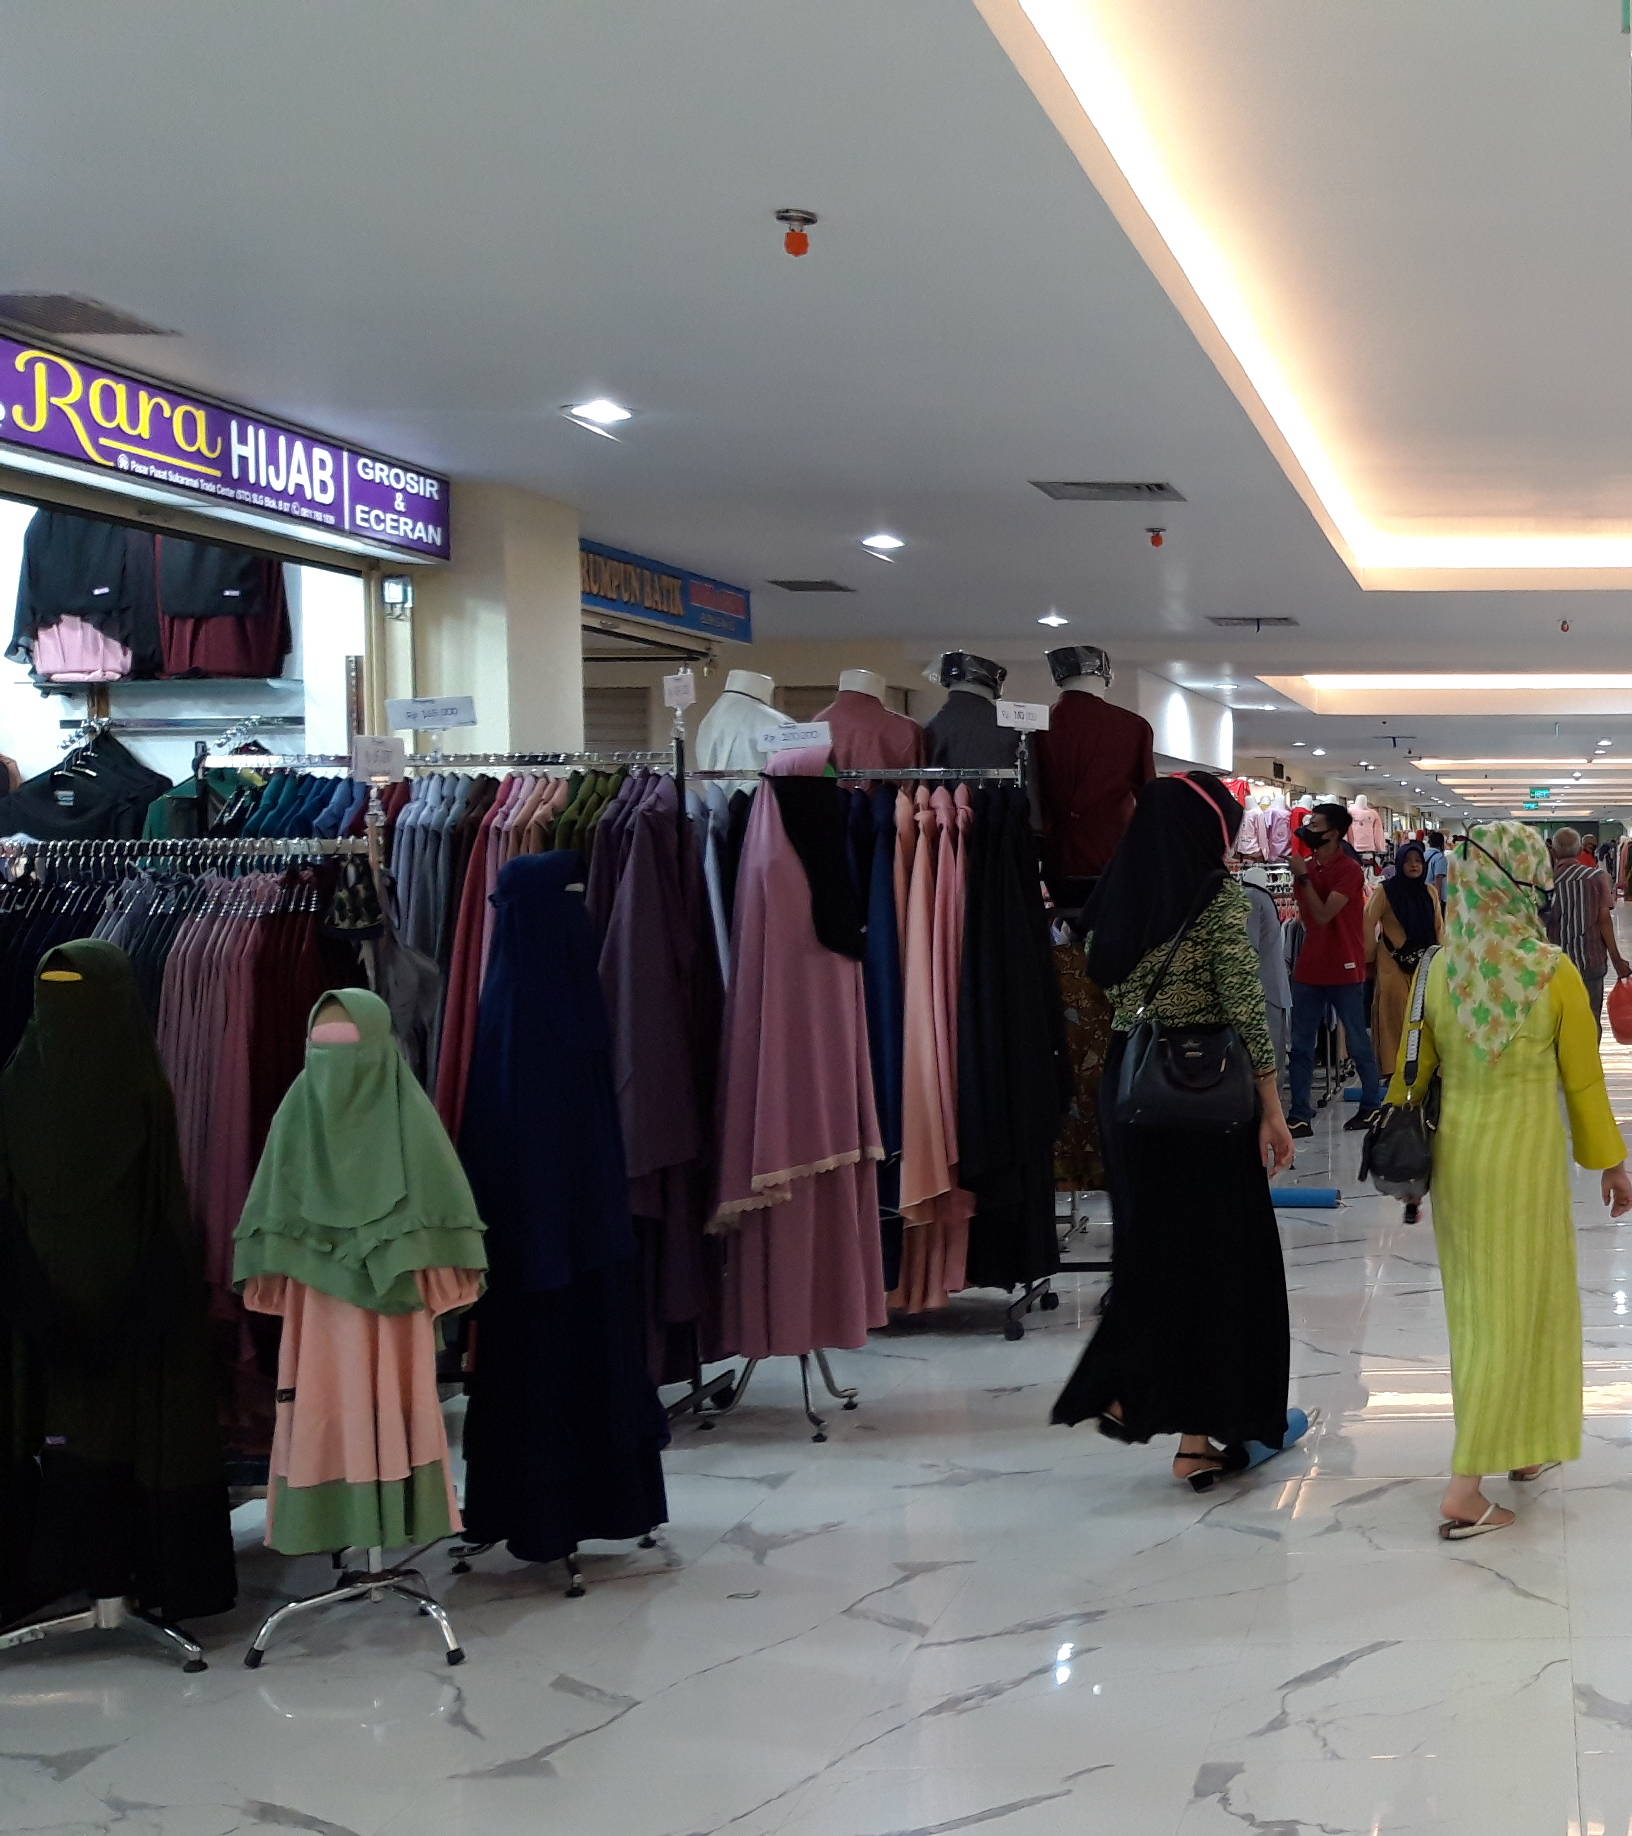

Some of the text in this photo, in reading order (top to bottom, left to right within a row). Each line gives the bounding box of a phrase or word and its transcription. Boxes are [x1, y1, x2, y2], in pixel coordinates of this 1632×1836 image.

[12, 349, 335, 505] Rara HIJAB
[357, 457, 440, 501] GROSIR
[394, 492, 407, 512] &
[355, 504, 442, 546] ECERAN
[642, 568, 685, 617] BATIK
